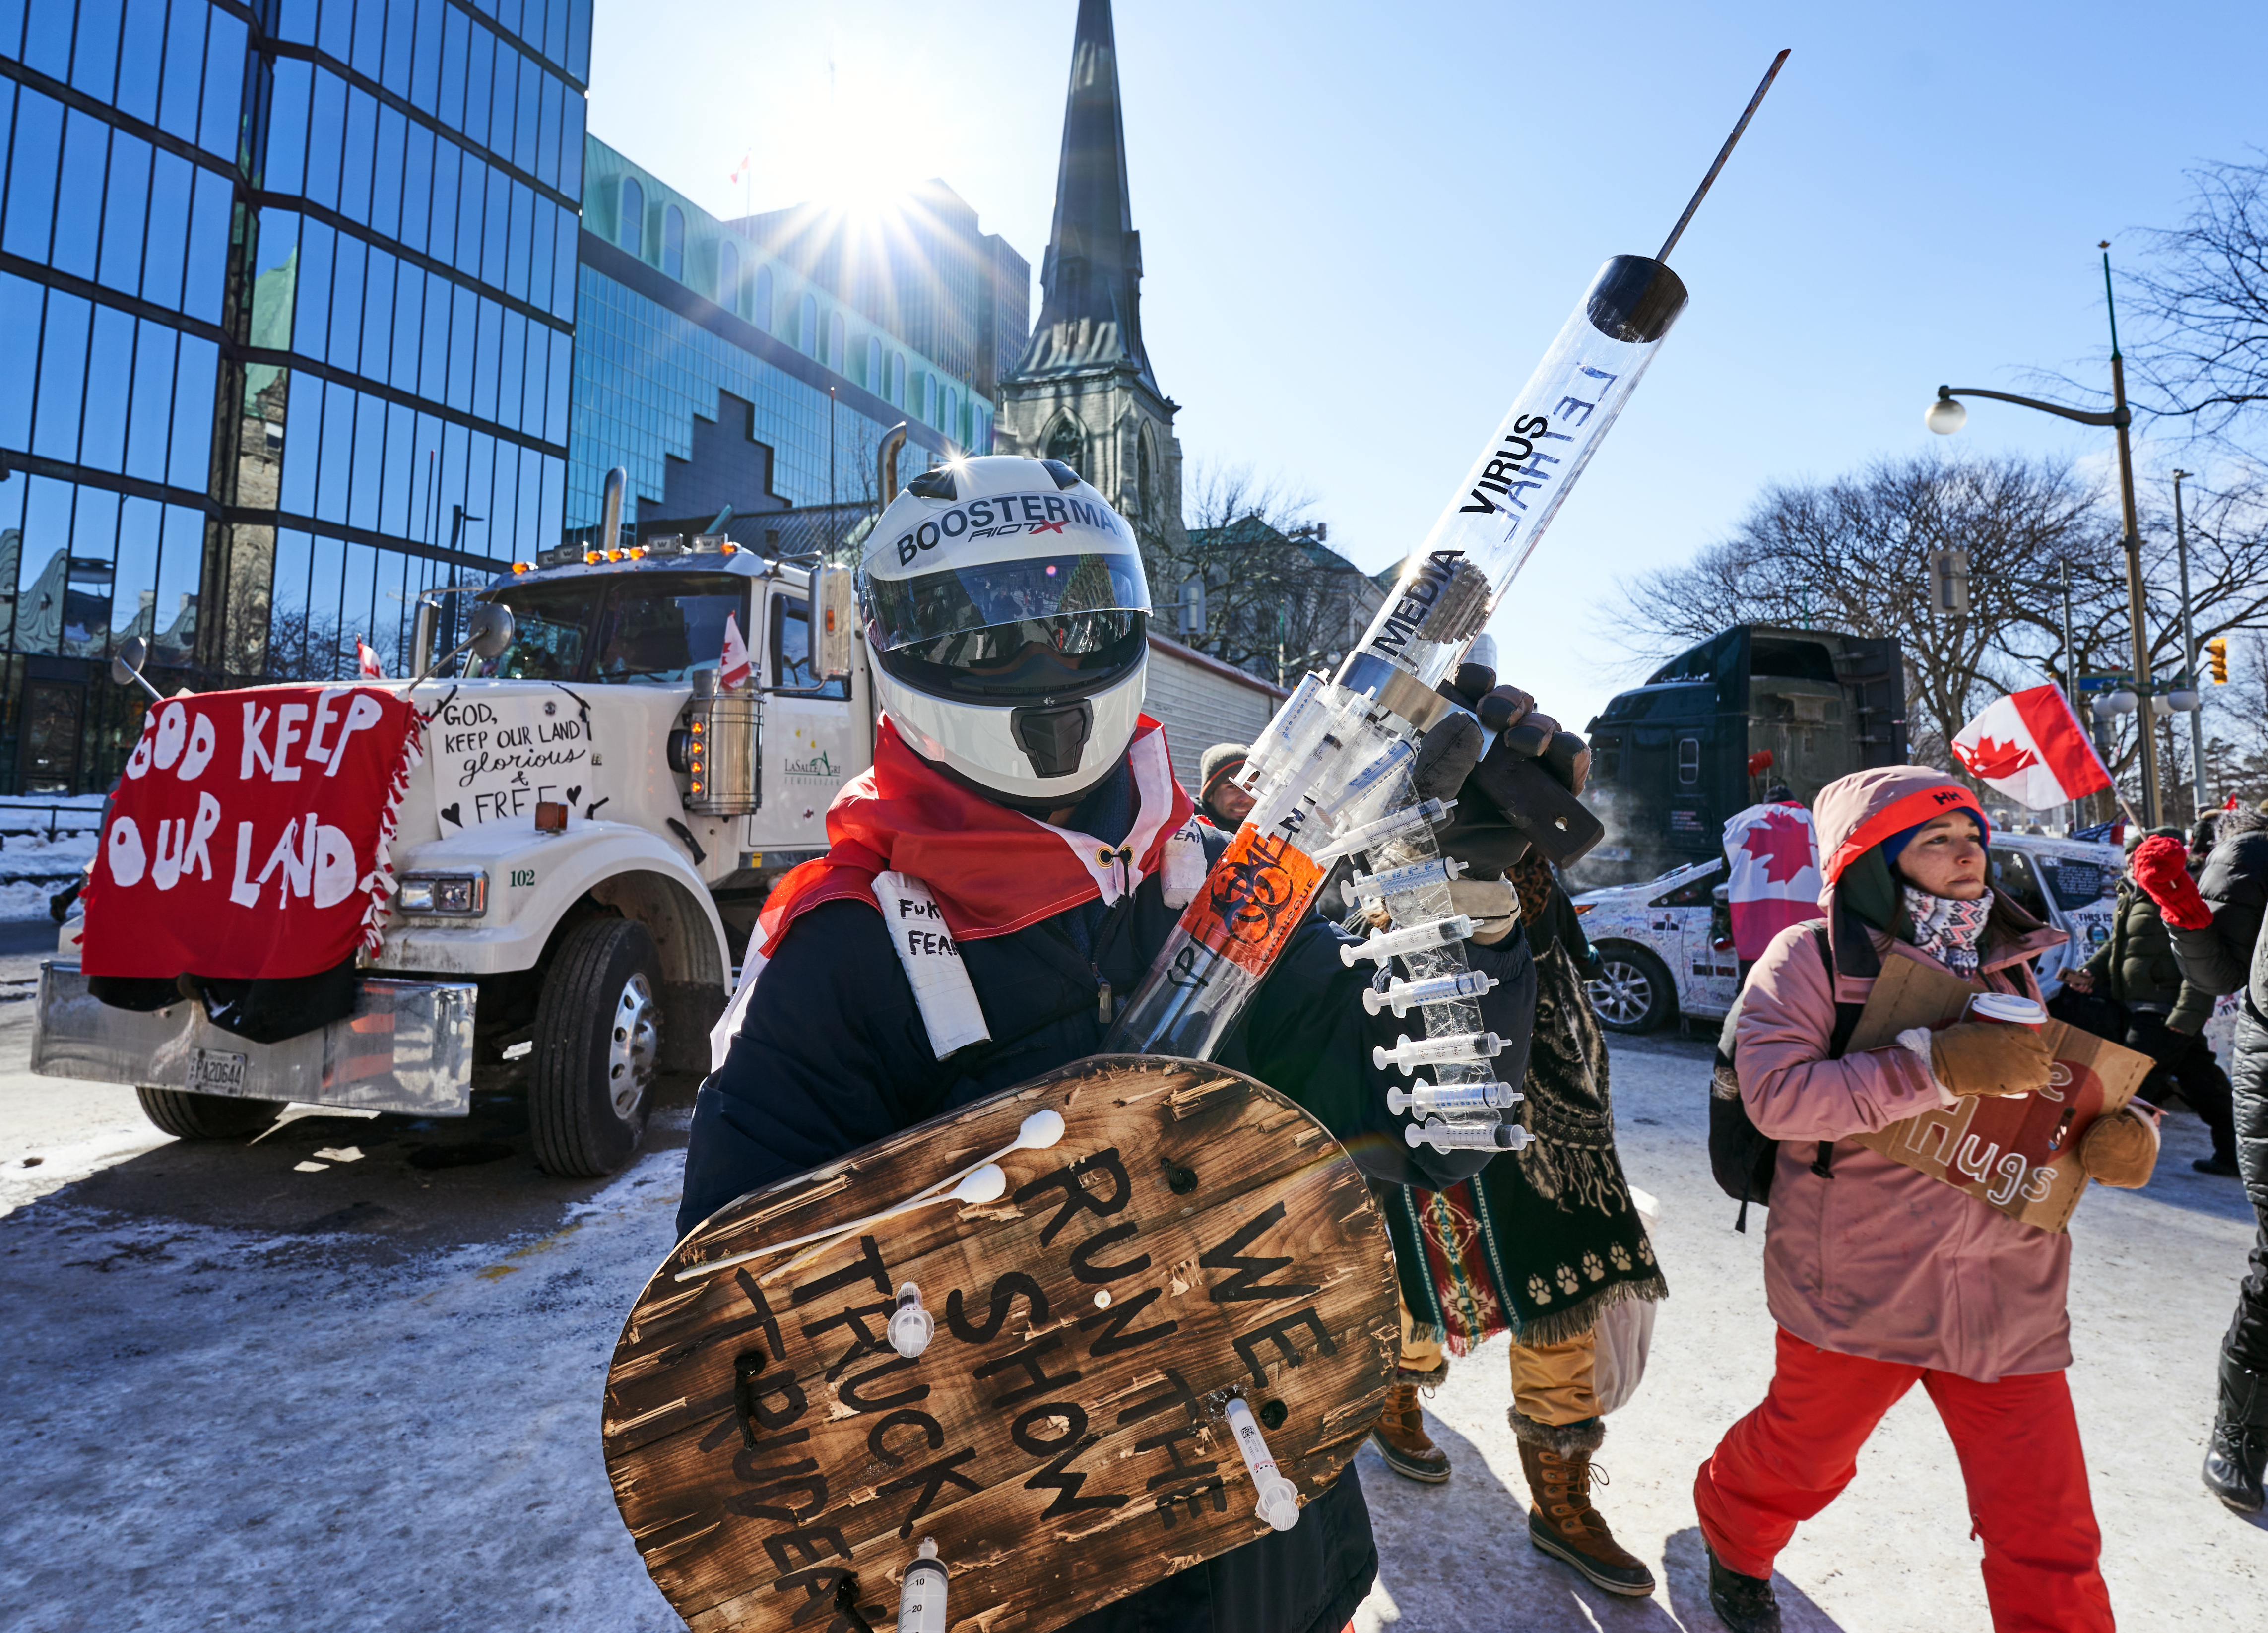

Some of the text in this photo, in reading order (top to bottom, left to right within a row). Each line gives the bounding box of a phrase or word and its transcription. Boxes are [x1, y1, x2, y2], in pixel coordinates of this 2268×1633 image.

[1459, 414, 1548, 514] VIRUS
[1371, 550, 1465, 657] MEDIA
[126, 687, 382, 781] GOD KEEP
[444, 703, 498, 726] GOD,
[446, 720, 580, 754] KEEP OUR LAND
[459, 749, 586, 787] glorious
[511, 771, 529, 786] &
[784, 777, 840, 786] FERTILIZER
[1933, 791, 1964, 805] HH
[109, 792, 356, 909] OUR LAND
[510, 870, 535, 887] 102
[898, 899, 940, 919] FUK
[1905, 1095, 2060, 1205] Hugs
[1200, 1200, 1338, 1388] WE
[1013, 1147, 1229, 1530] RUN THE
[792, 1235, 985, 1539] TRUCK
[947, 1271, 1130, 1522] SHOW
[912, 1604, 922, 1613] 20
